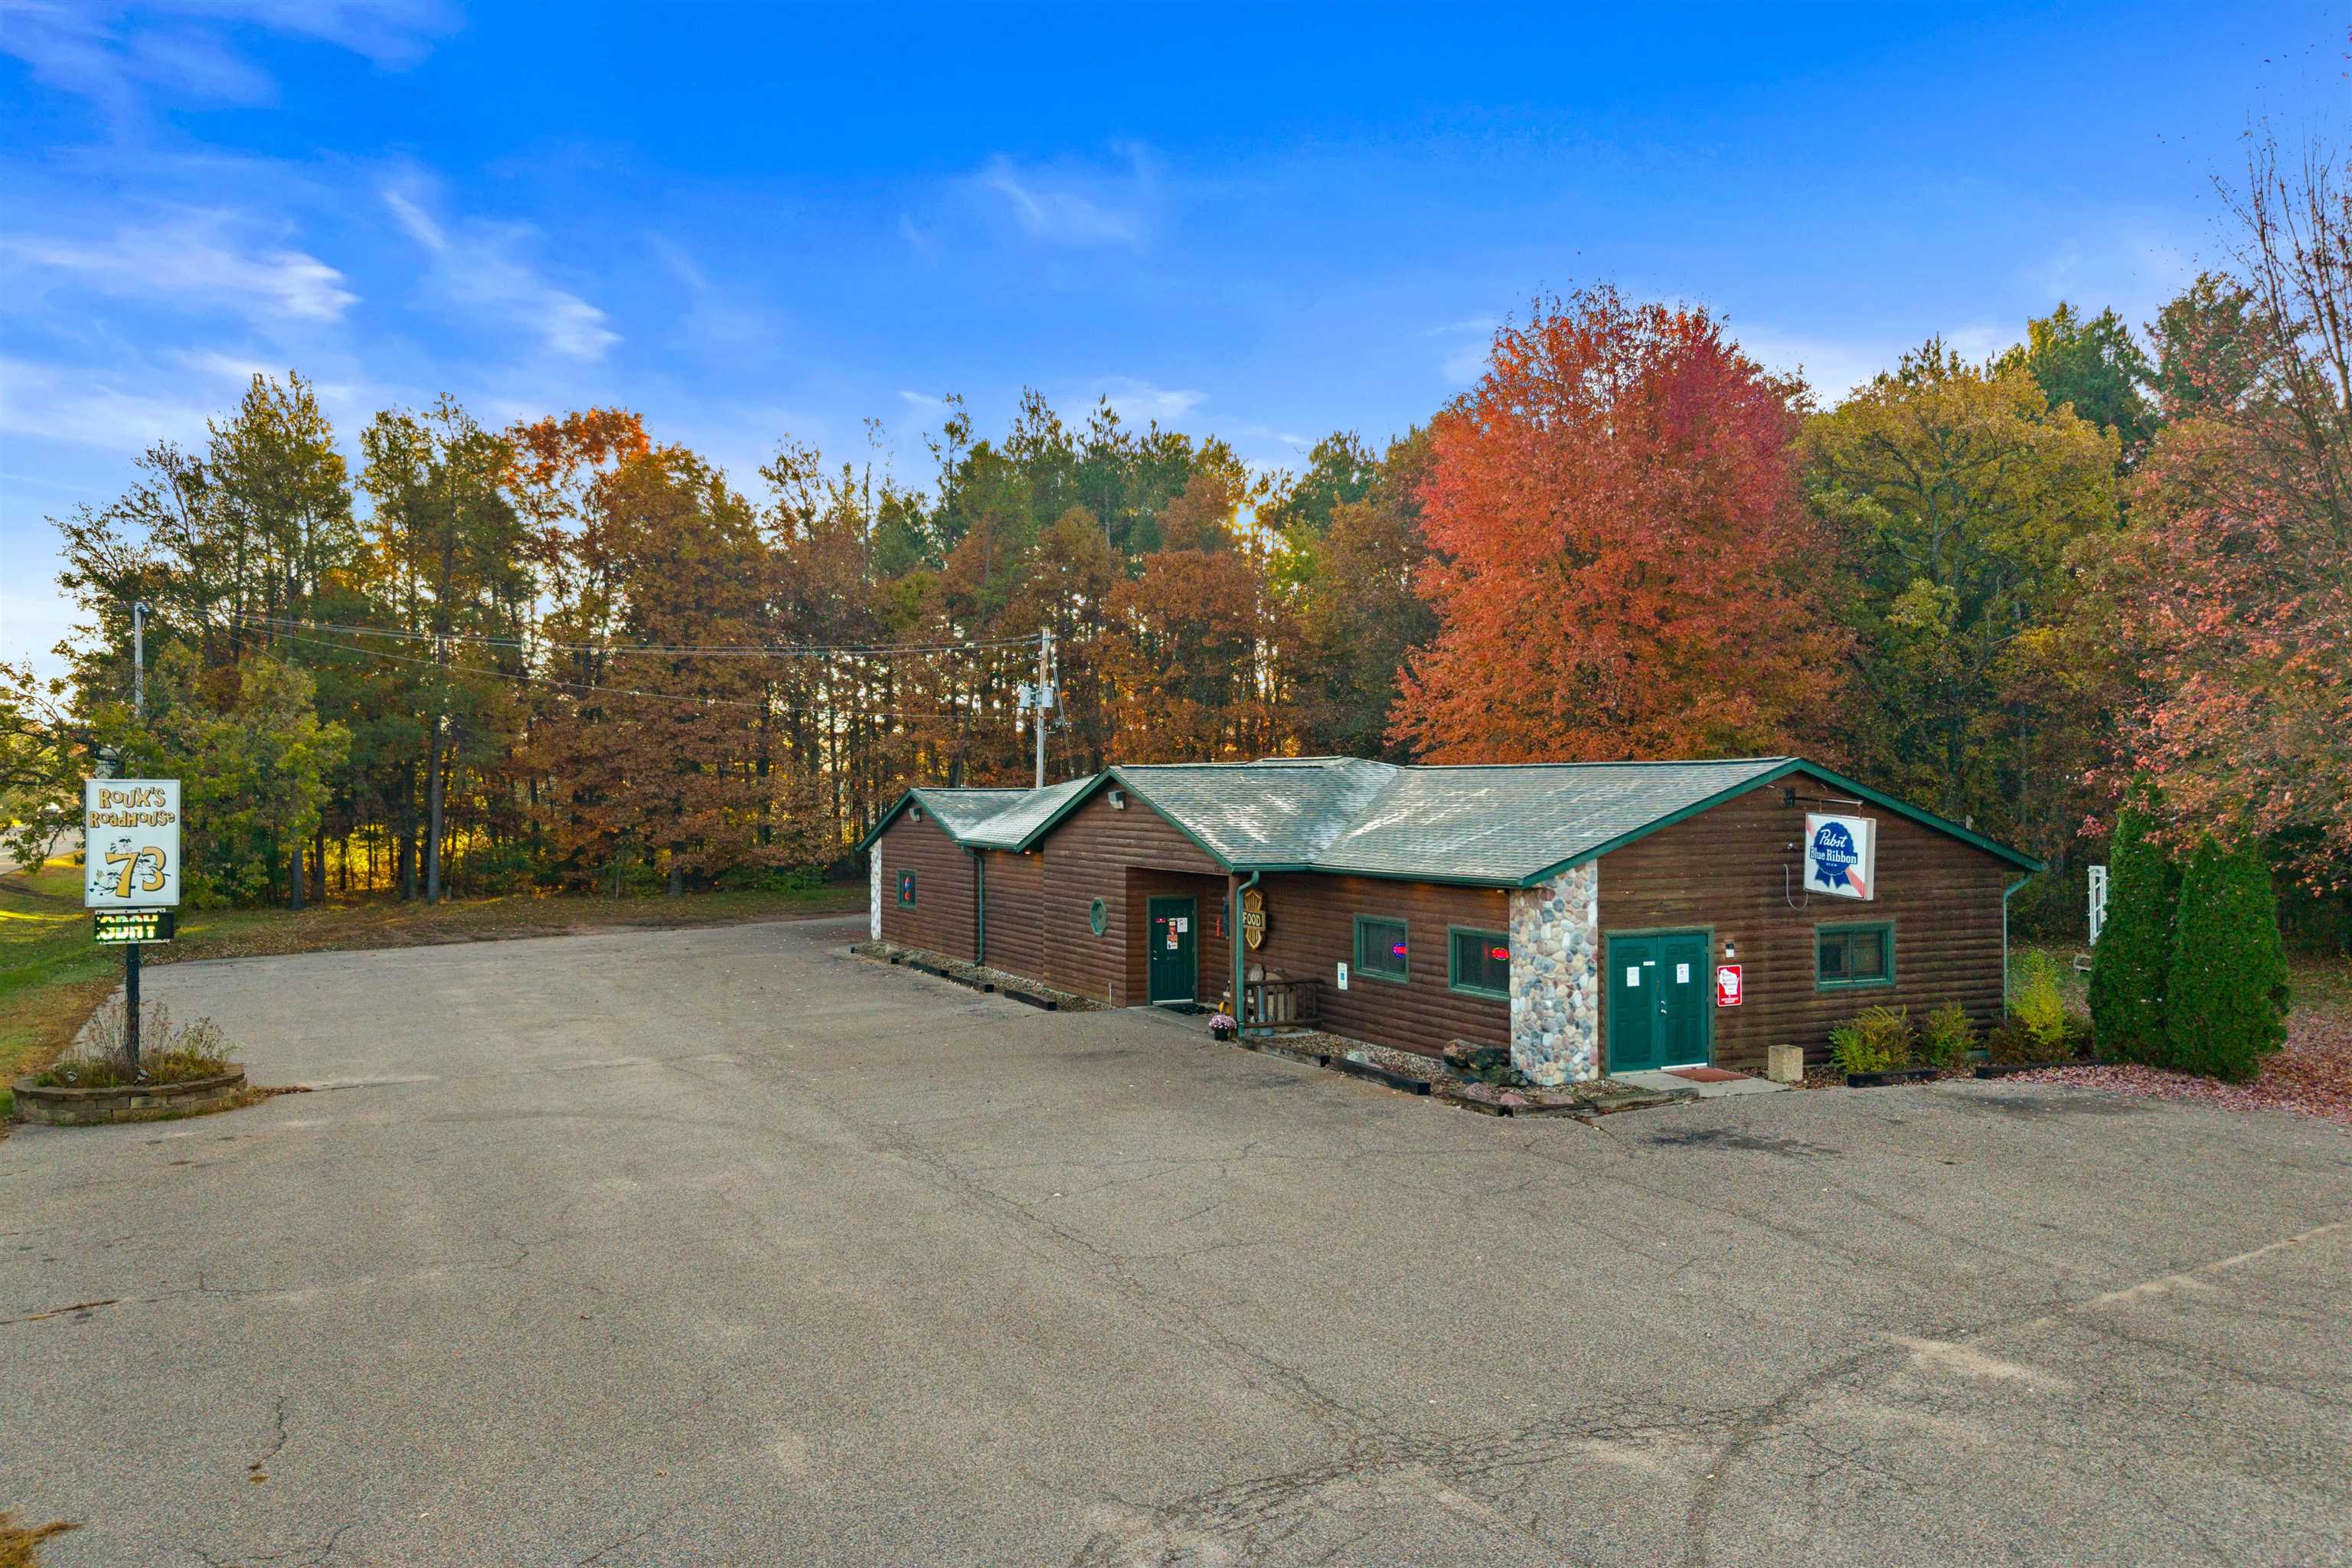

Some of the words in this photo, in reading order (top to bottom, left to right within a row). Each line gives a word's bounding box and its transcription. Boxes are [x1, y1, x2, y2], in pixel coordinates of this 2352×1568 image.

[1819, 828, 1847, 848] Pabst
[1810, 846, 1825, 860] Blue
[1826, 848, 1857, 864] Ribbon
[105, 846, 166, 898] 73
[1243, 911, 1261, 926] FOOD
